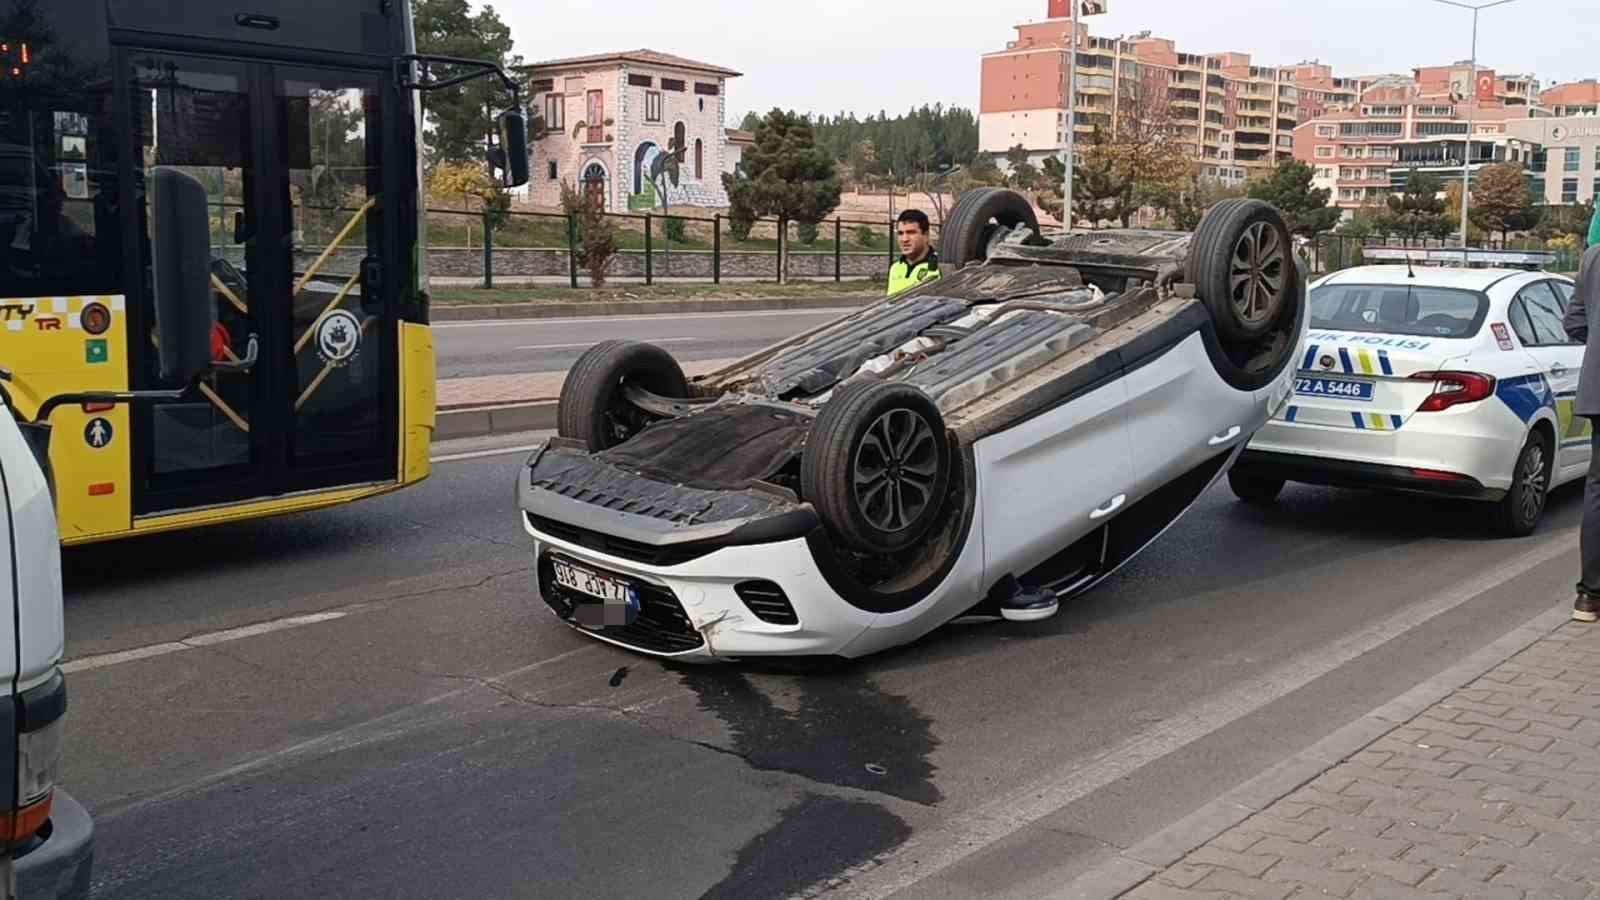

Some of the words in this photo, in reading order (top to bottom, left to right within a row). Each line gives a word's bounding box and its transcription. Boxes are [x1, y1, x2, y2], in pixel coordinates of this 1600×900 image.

[34, 317, 62, 330] TR
[1313, 382, 1324, 392] A
[1328, 382, 1361, 396] 5446
